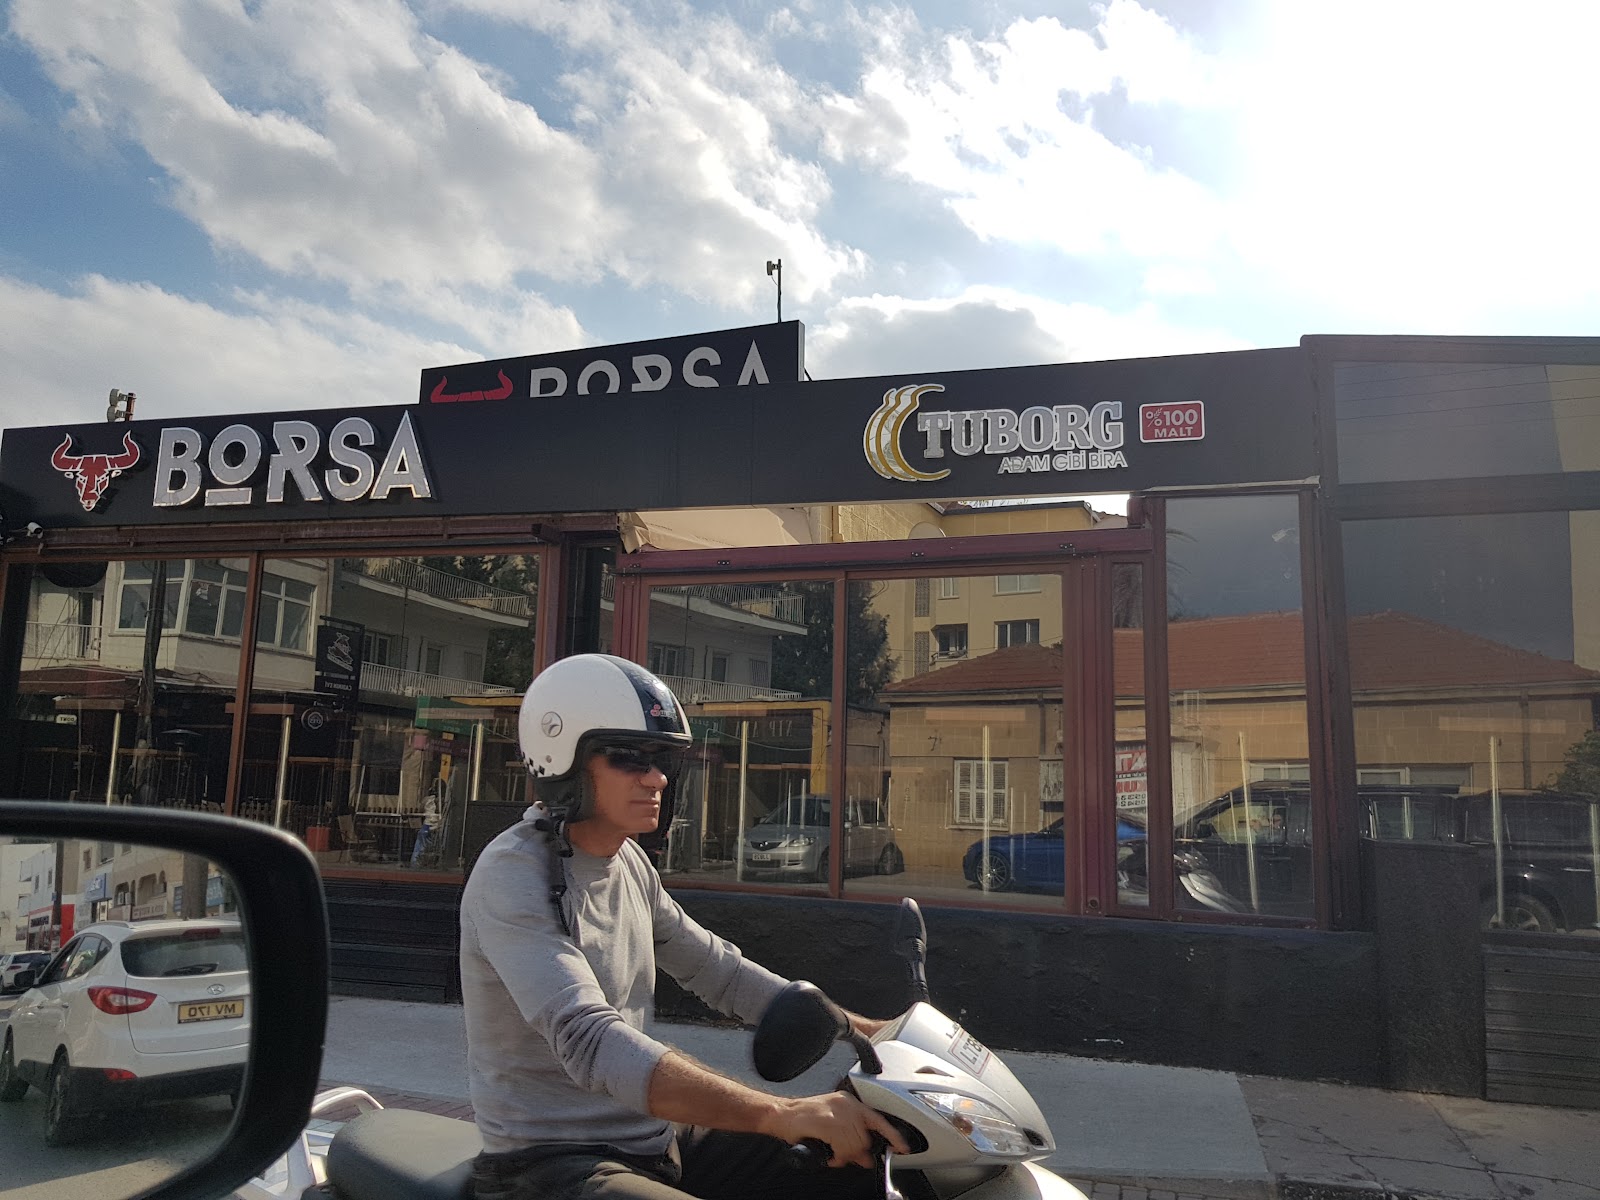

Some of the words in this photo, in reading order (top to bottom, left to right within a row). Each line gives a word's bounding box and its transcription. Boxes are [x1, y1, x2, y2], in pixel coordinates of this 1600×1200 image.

[917, 400, 1123, 459] TUBORG
[1154, 426, 1194, 438] MALT
[153, 410, 432, 507] BORSA
[997, 453, 1051, 474] ADAM
